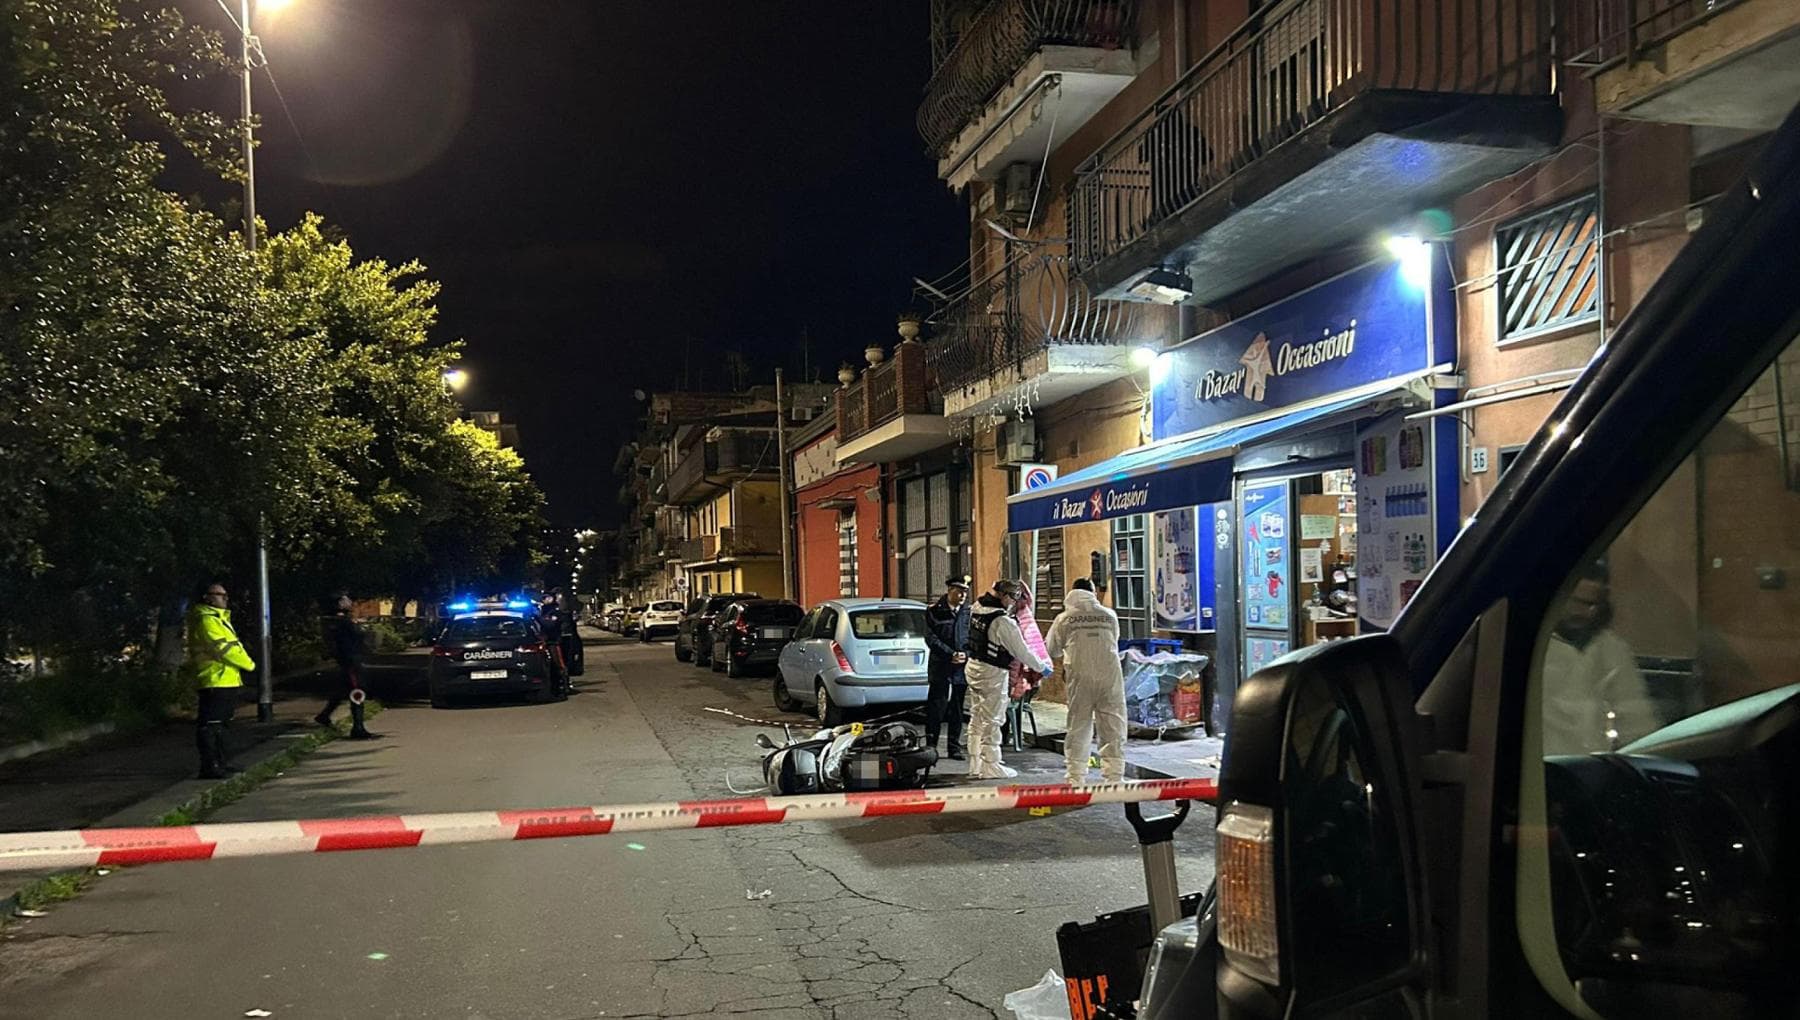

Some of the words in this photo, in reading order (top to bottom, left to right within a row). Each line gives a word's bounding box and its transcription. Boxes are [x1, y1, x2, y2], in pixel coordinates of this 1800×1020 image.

[1205, 368, 1246, 400] Bazar
[1277, 319, 1357, 375] Occasioni
[1053, 502, 1060, 519] il
[1061, 498, 1086, 520] Bazar
[1106, 482, 1149, 511] Occasioni
[464, 650, 512, 660] CARABINIERI
